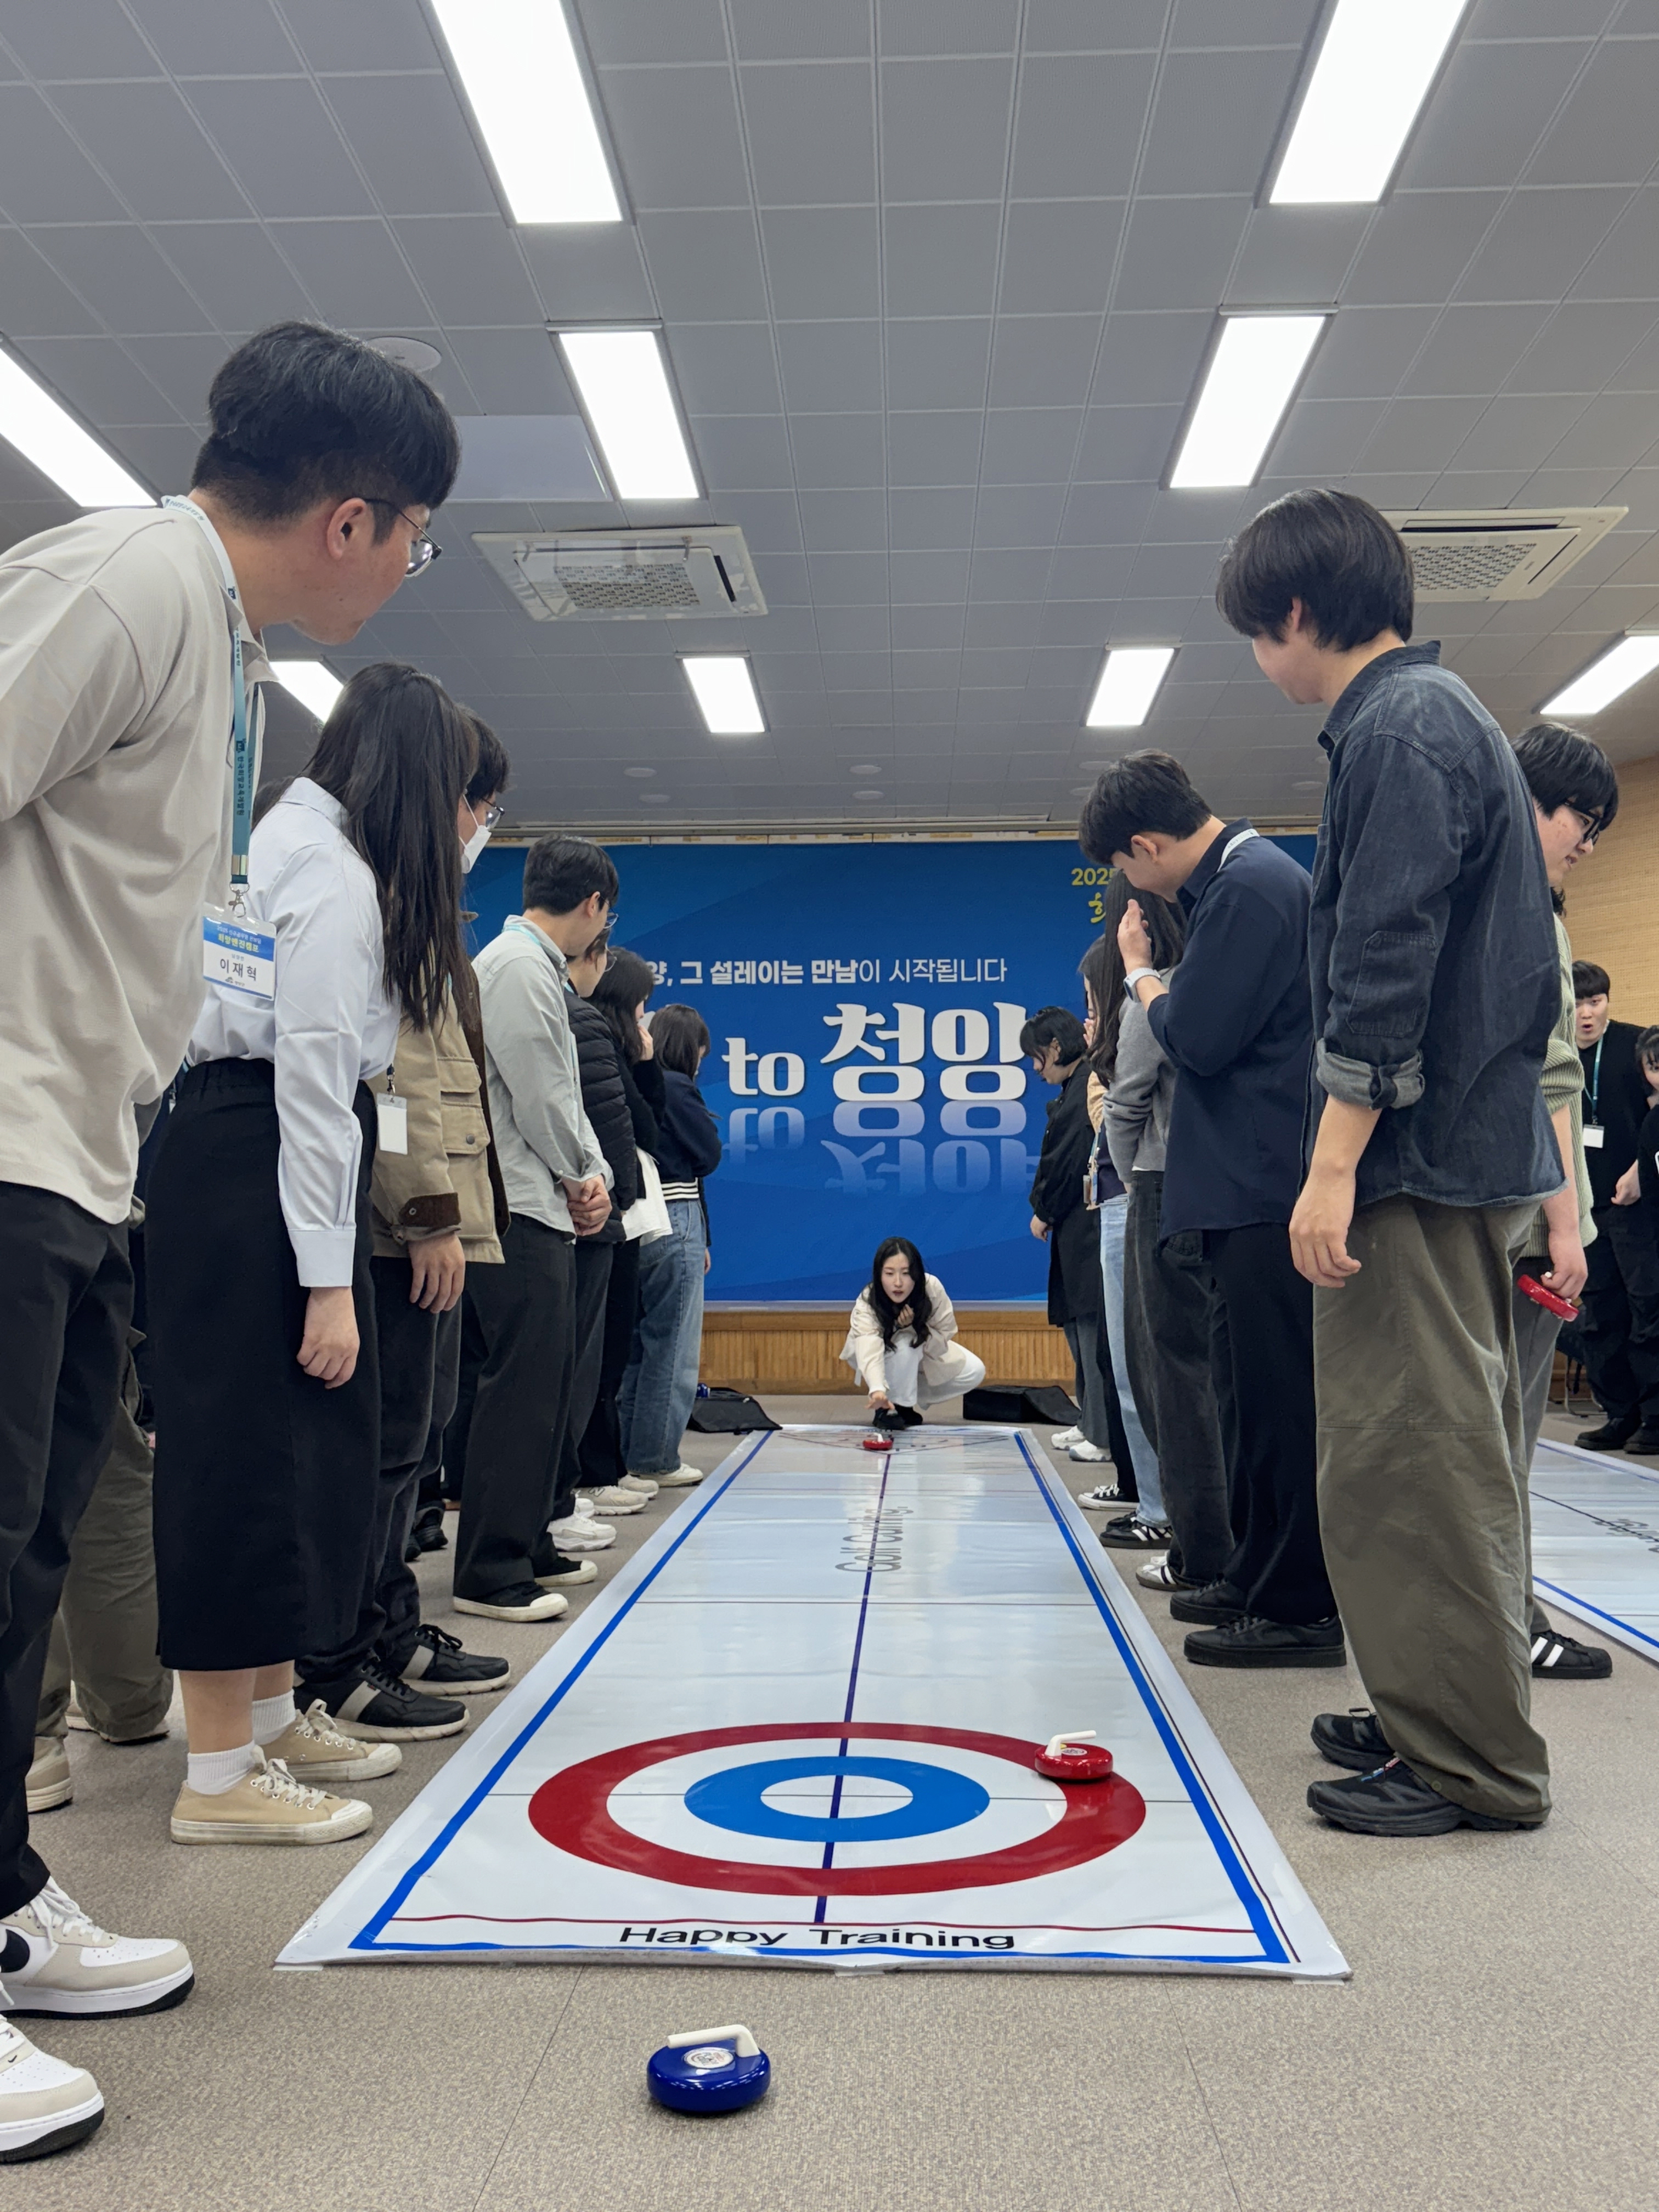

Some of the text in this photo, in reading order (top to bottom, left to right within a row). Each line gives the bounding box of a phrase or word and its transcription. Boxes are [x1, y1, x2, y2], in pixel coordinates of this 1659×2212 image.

[680, 961, 703, 984] 그
[710, 960, 804, 985] 설레이는
[811, 959, 881, 984] 만남이
[889, 958, 1007, 983] 시작됩니다
[721, 1002, 1027, 1101] to 청양
[835, 1547, 902, 1573] Golf
[619, 1927, 1014, 1949] Happy Training
